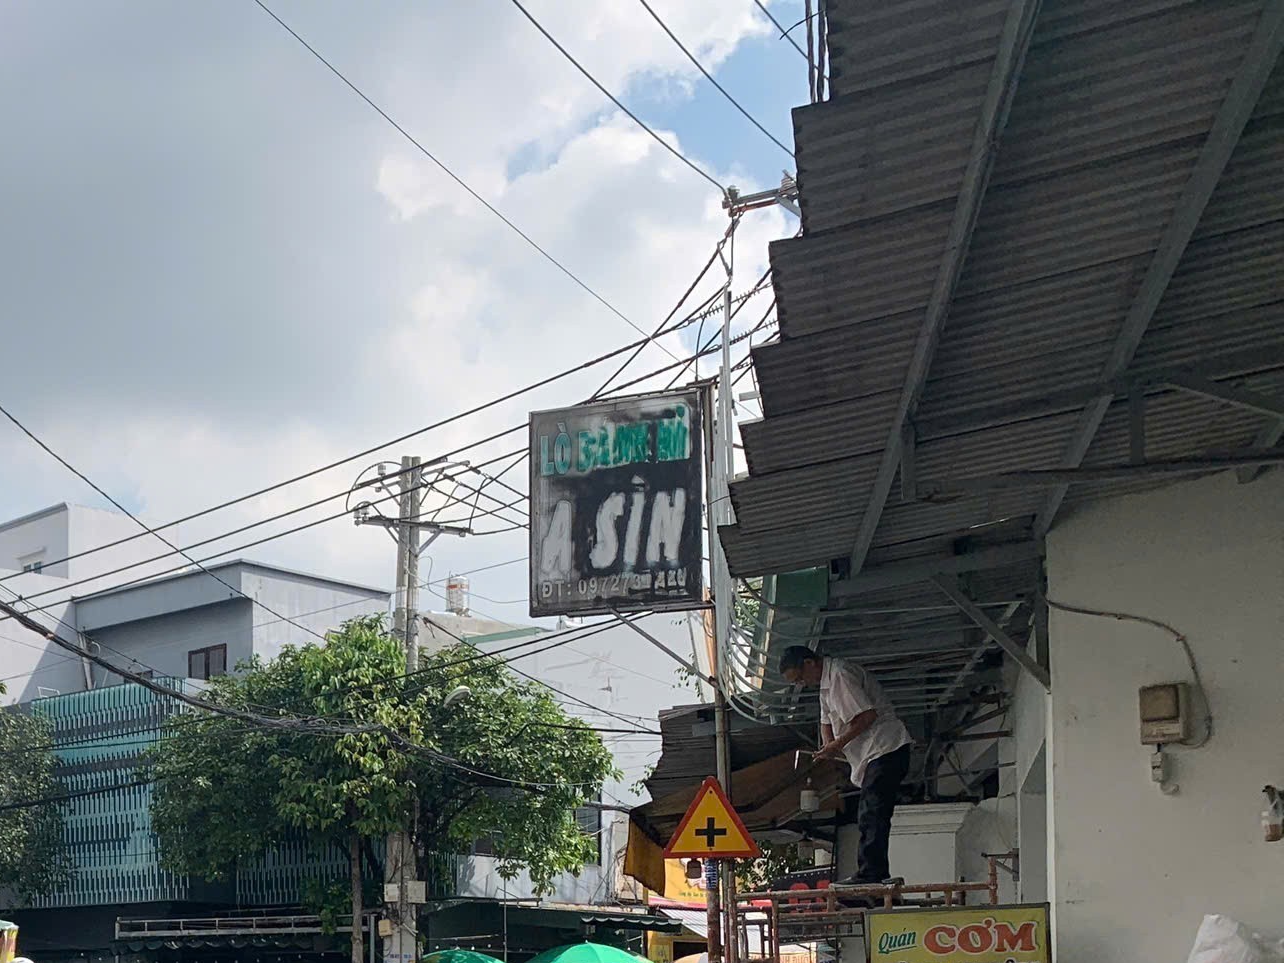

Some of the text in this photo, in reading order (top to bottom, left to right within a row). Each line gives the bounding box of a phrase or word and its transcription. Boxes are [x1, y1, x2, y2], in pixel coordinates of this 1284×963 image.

[541, 423, 571, 476] LÒ
[878, 919, 1037, 955] Quán CƠM
